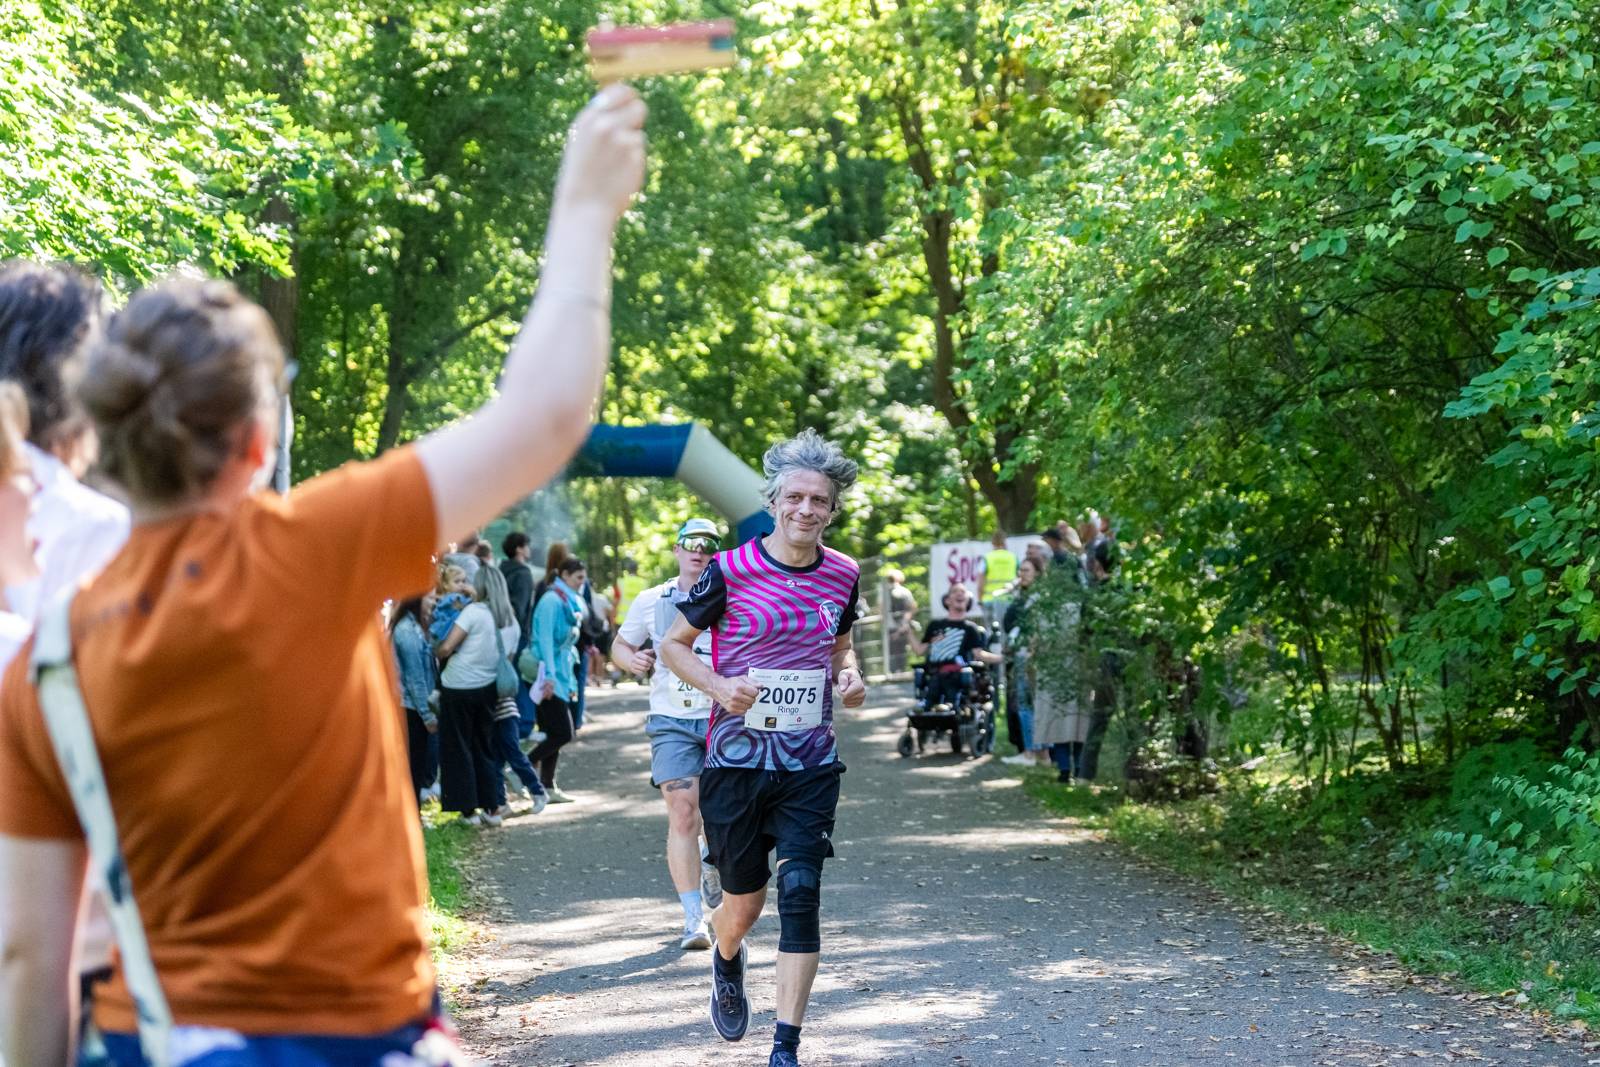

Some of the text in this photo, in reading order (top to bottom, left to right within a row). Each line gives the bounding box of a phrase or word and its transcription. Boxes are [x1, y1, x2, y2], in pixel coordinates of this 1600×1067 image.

[677, 681, 693, 692] 20
[758, 686, 817, 705] 20075
[777, 705, 800, 716] Ringo
